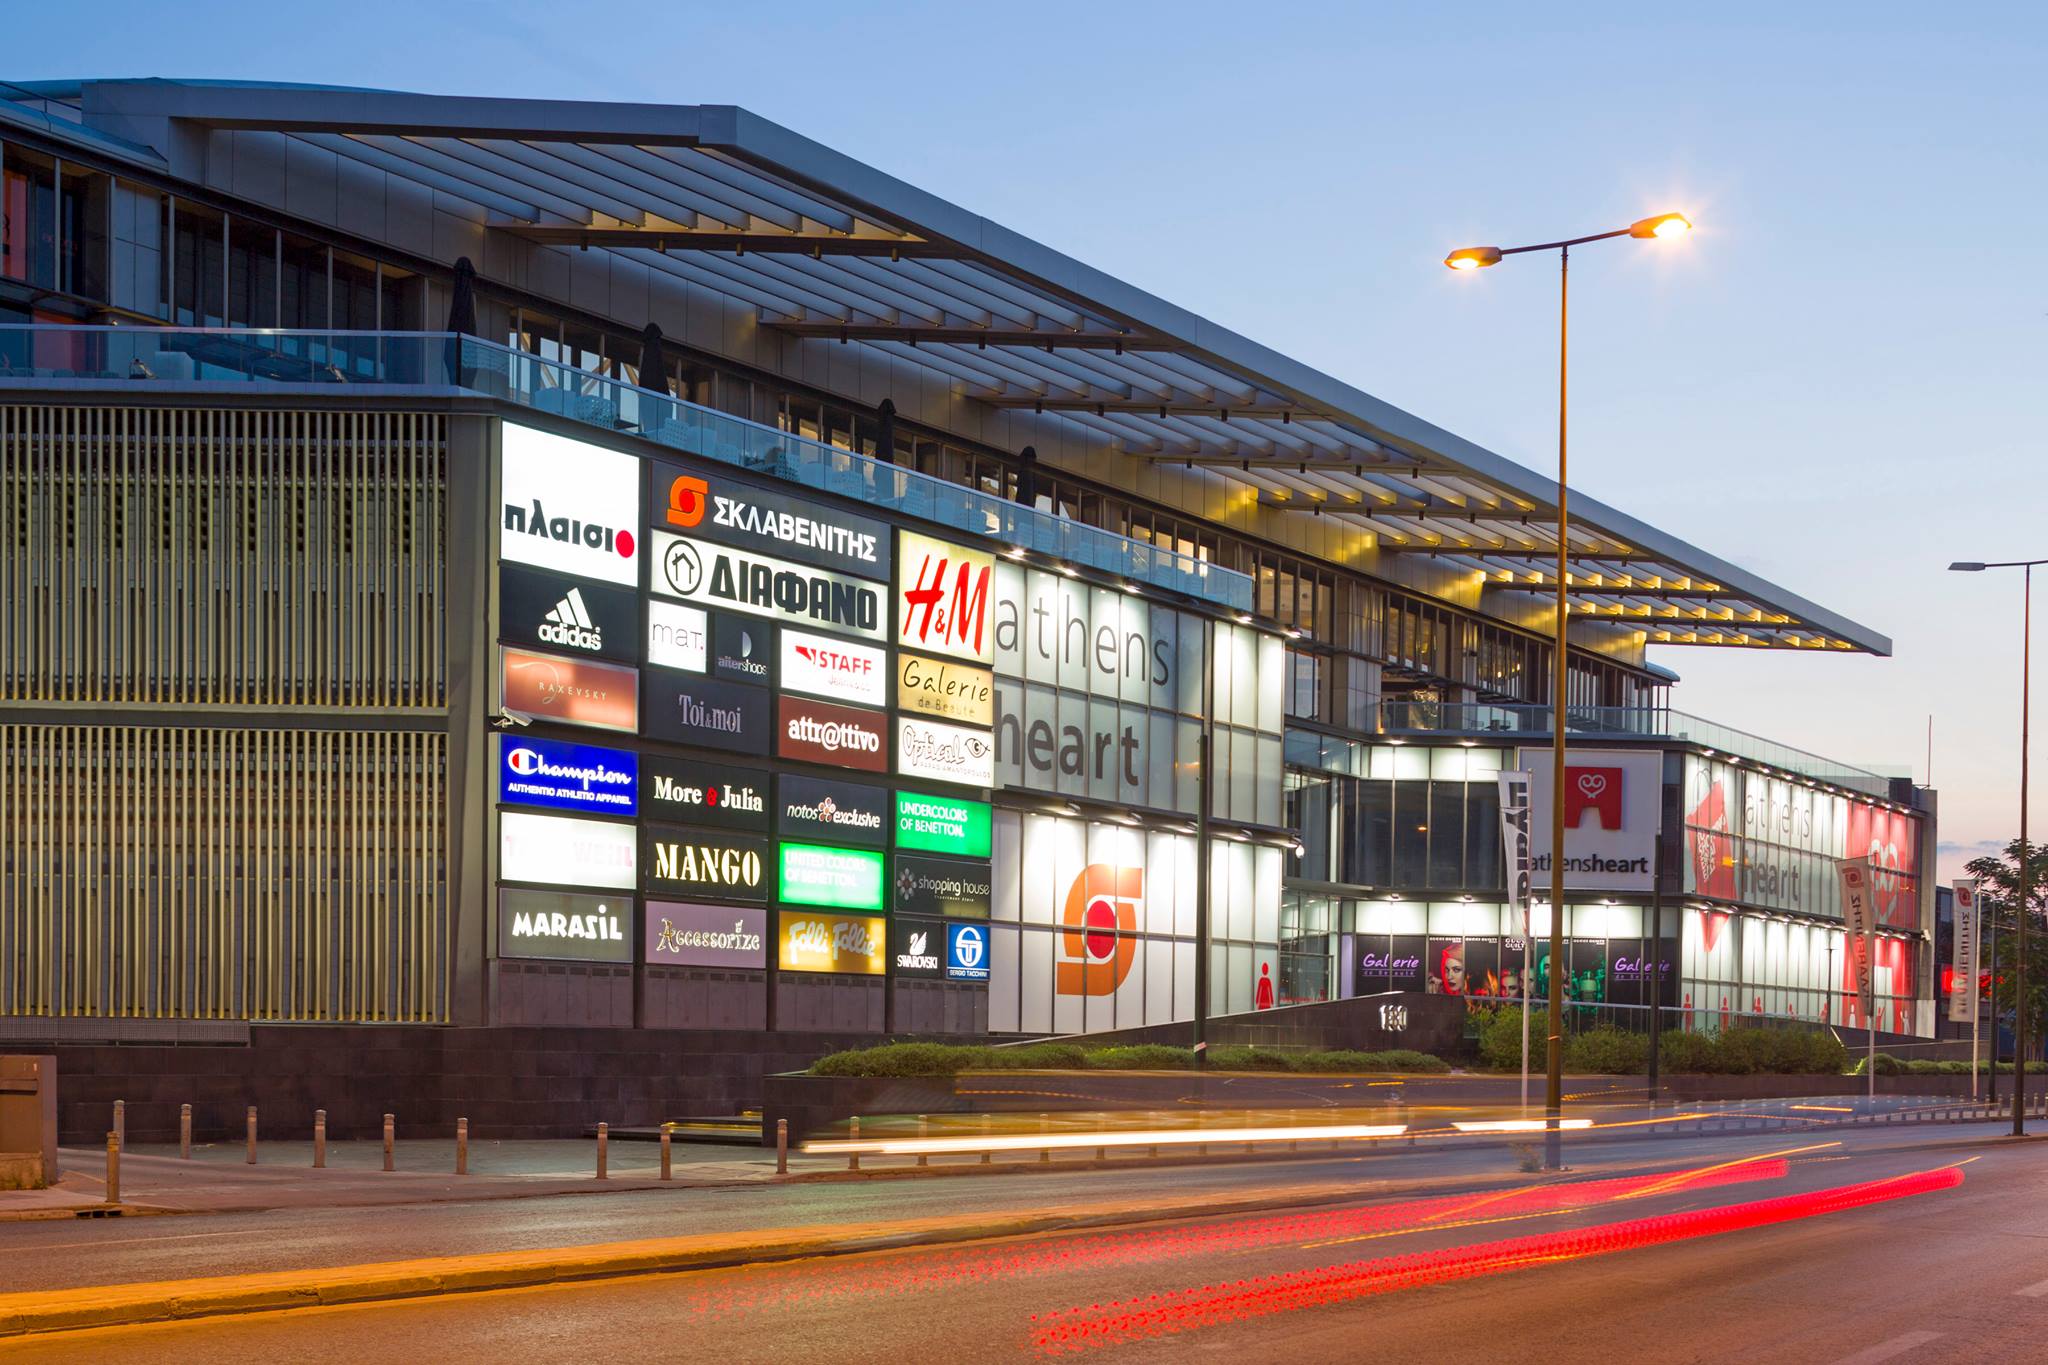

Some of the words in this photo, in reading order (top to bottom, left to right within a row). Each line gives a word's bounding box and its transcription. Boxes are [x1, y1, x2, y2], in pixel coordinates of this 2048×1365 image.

[713, 495, 877, 562] ΣΚΛΑΒΕΝΙΤΗΣ
[708, 553, 878, 631] ΔΙΑΦΑΝΟ
[903, 553, 990, 656] H&M
[538, 622, 602, 651] adidas
[995, 594, 1169, 686] athens
[819, 650, 872, 676] STAFF
[903, 660, 989, 702] Galerie
[539, 681, 607, 701] RAXEVSKY
[788, 716, 880, 752] attr@ttivo
[903, 725, 966, 767] Optical
[994, 690, 1139, 786] heart
[508, 748, 632, 791] Champion
[508, 782, 556, 797] AUTHENTIC
[556, 788, 595, 802] ATHLETIC
[596, 793, 632, 805] APPAREL
[653, 775, 703, 805] More
[720, 784, 764, 812] Julia
[900, 801, 969, 822] UNDERCOLORS
[787, 804, 819, 820] notos
[832, 808, 881, 828] exclusive
[900, 817, 914, 831] OF
[1746, 787, 1810, 838] athens
[655, 842, 761, 887] MANGO
[1744, 850, 1799, 902] heart
[918, 875, 961, 896] shopping
[962, 879, 990, 895] house
[656, 918, 760, 953] Accessorize
[789, 921, 829, 965] Folli
[832, 922, 876, 961] Follie
[897, 955, 938, 969] SWAROVSKI
[1363, 953, 1420, 968] Galerie
[1615, 957, 1670, 972] Galeie
[1379, 1004, 1408, 1031] 180
